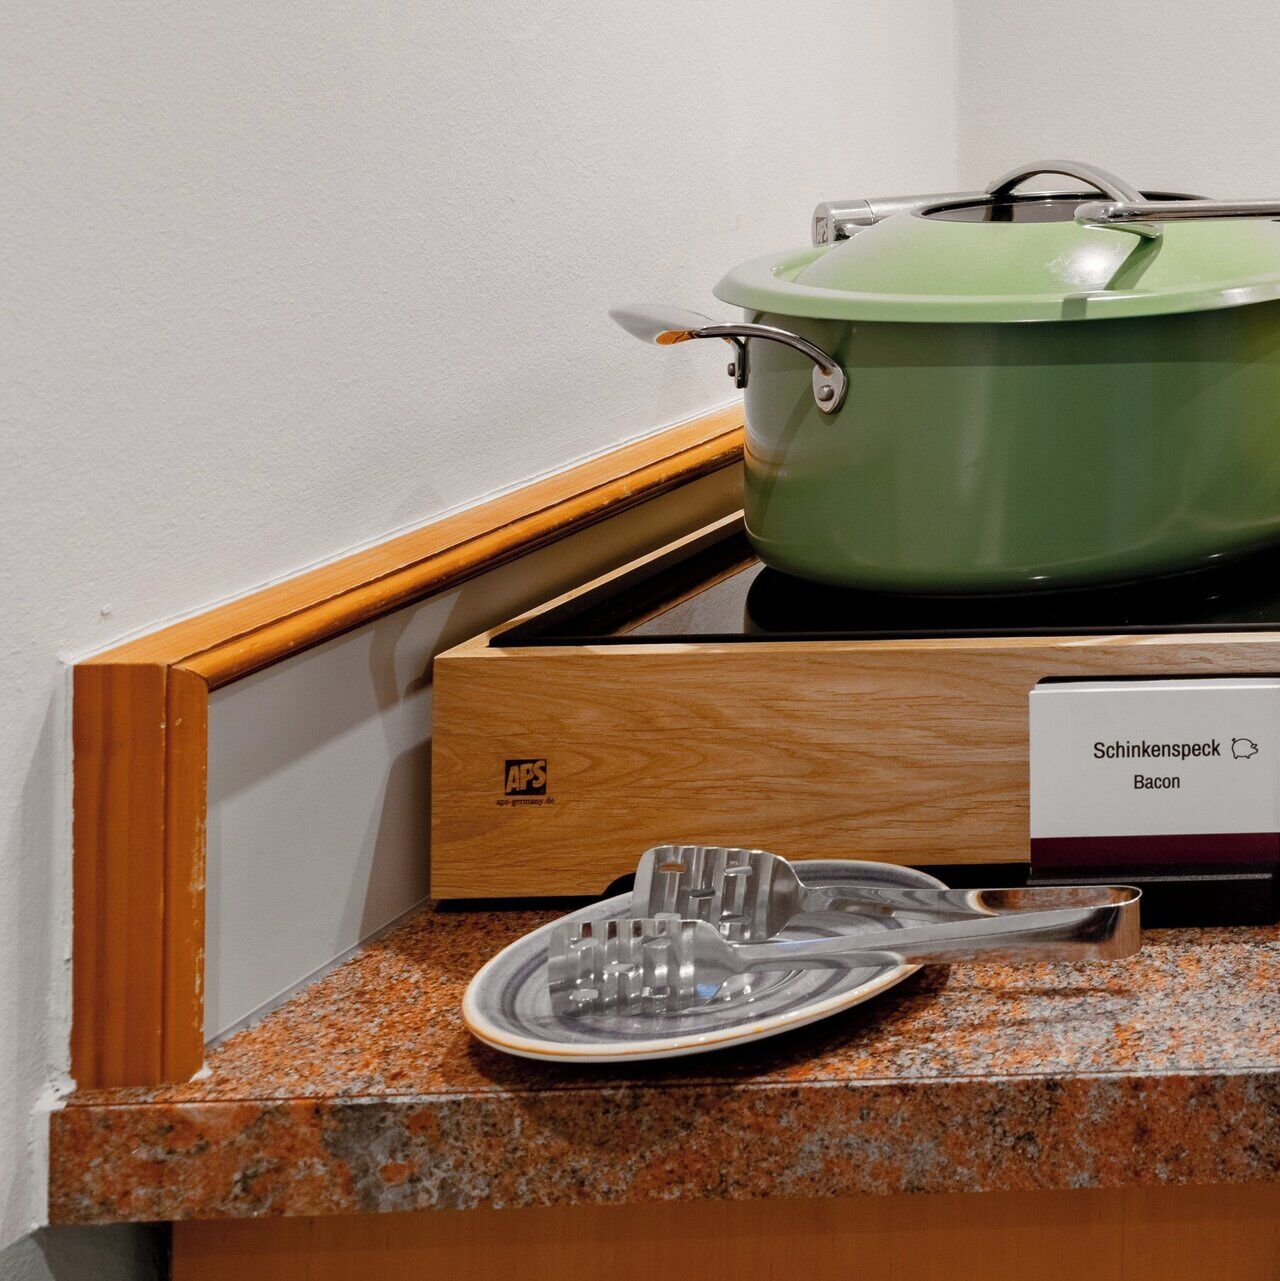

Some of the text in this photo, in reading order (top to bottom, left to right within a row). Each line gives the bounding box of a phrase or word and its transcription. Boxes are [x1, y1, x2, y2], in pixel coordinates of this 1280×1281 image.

[1093, 738, 1221, 760] Schinkenspeck
[505, 760, 546, 794] APS
[1134, 774, 1180, 789] Bacon
